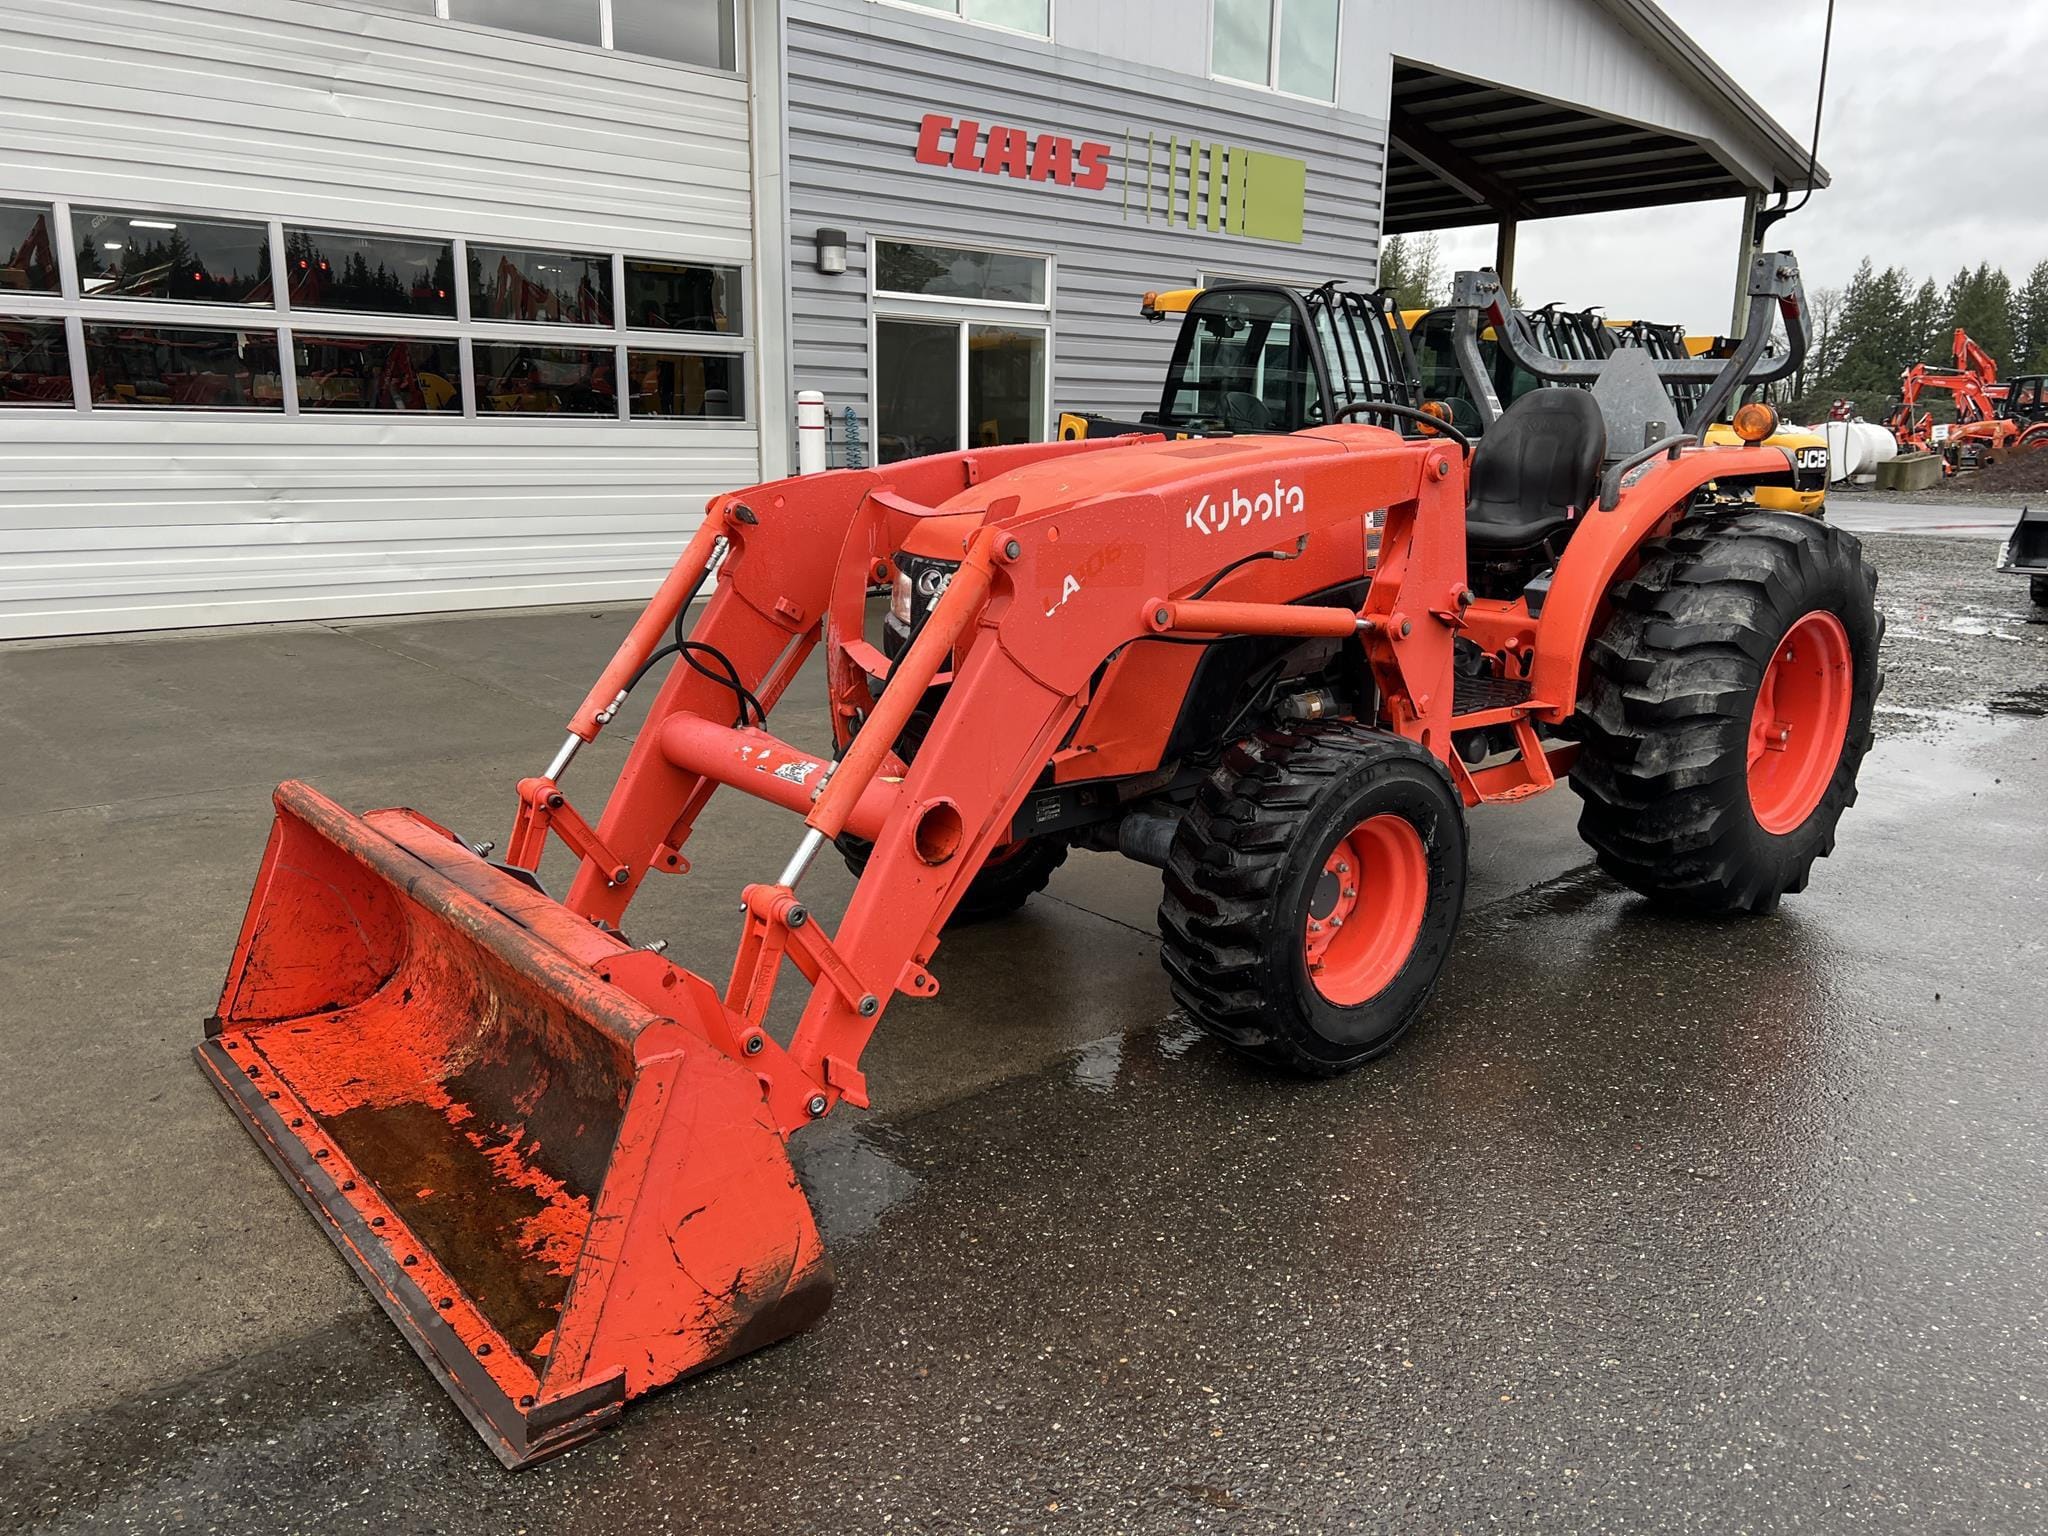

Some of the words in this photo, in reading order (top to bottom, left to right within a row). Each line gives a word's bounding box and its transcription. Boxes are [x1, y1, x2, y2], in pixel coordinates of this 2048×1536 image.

[914, 113, 1111, 191] CLAAS
[1797, 450, 1827, 469] JCB
[1185, 478, 1304, 535] Kubota
